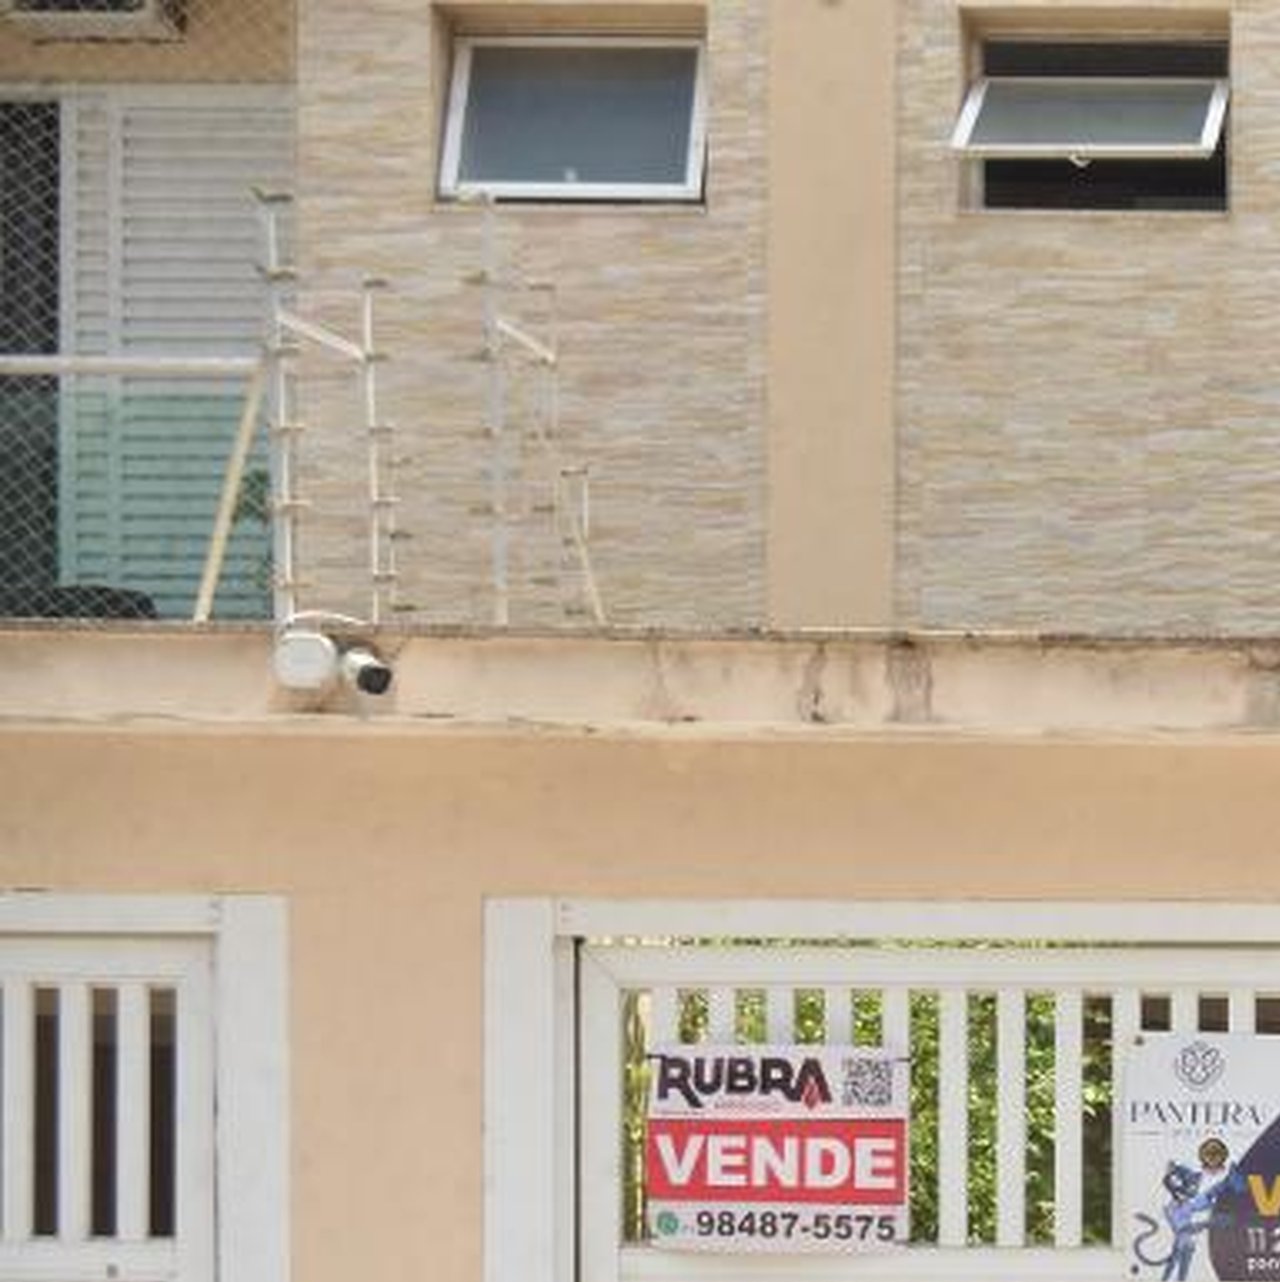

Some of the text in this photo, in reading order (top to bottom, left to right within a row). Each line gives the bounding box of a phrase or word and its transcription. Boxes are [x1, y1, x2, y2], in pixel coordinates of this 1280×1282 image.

[657, 1056, 832, 1109] RUBRA
[1130, 1100, 1263, 1126] PANTERA
[654, 1133, 897, 1190] VENDE
[696, 1210, 896, 1241] 98487-5575
